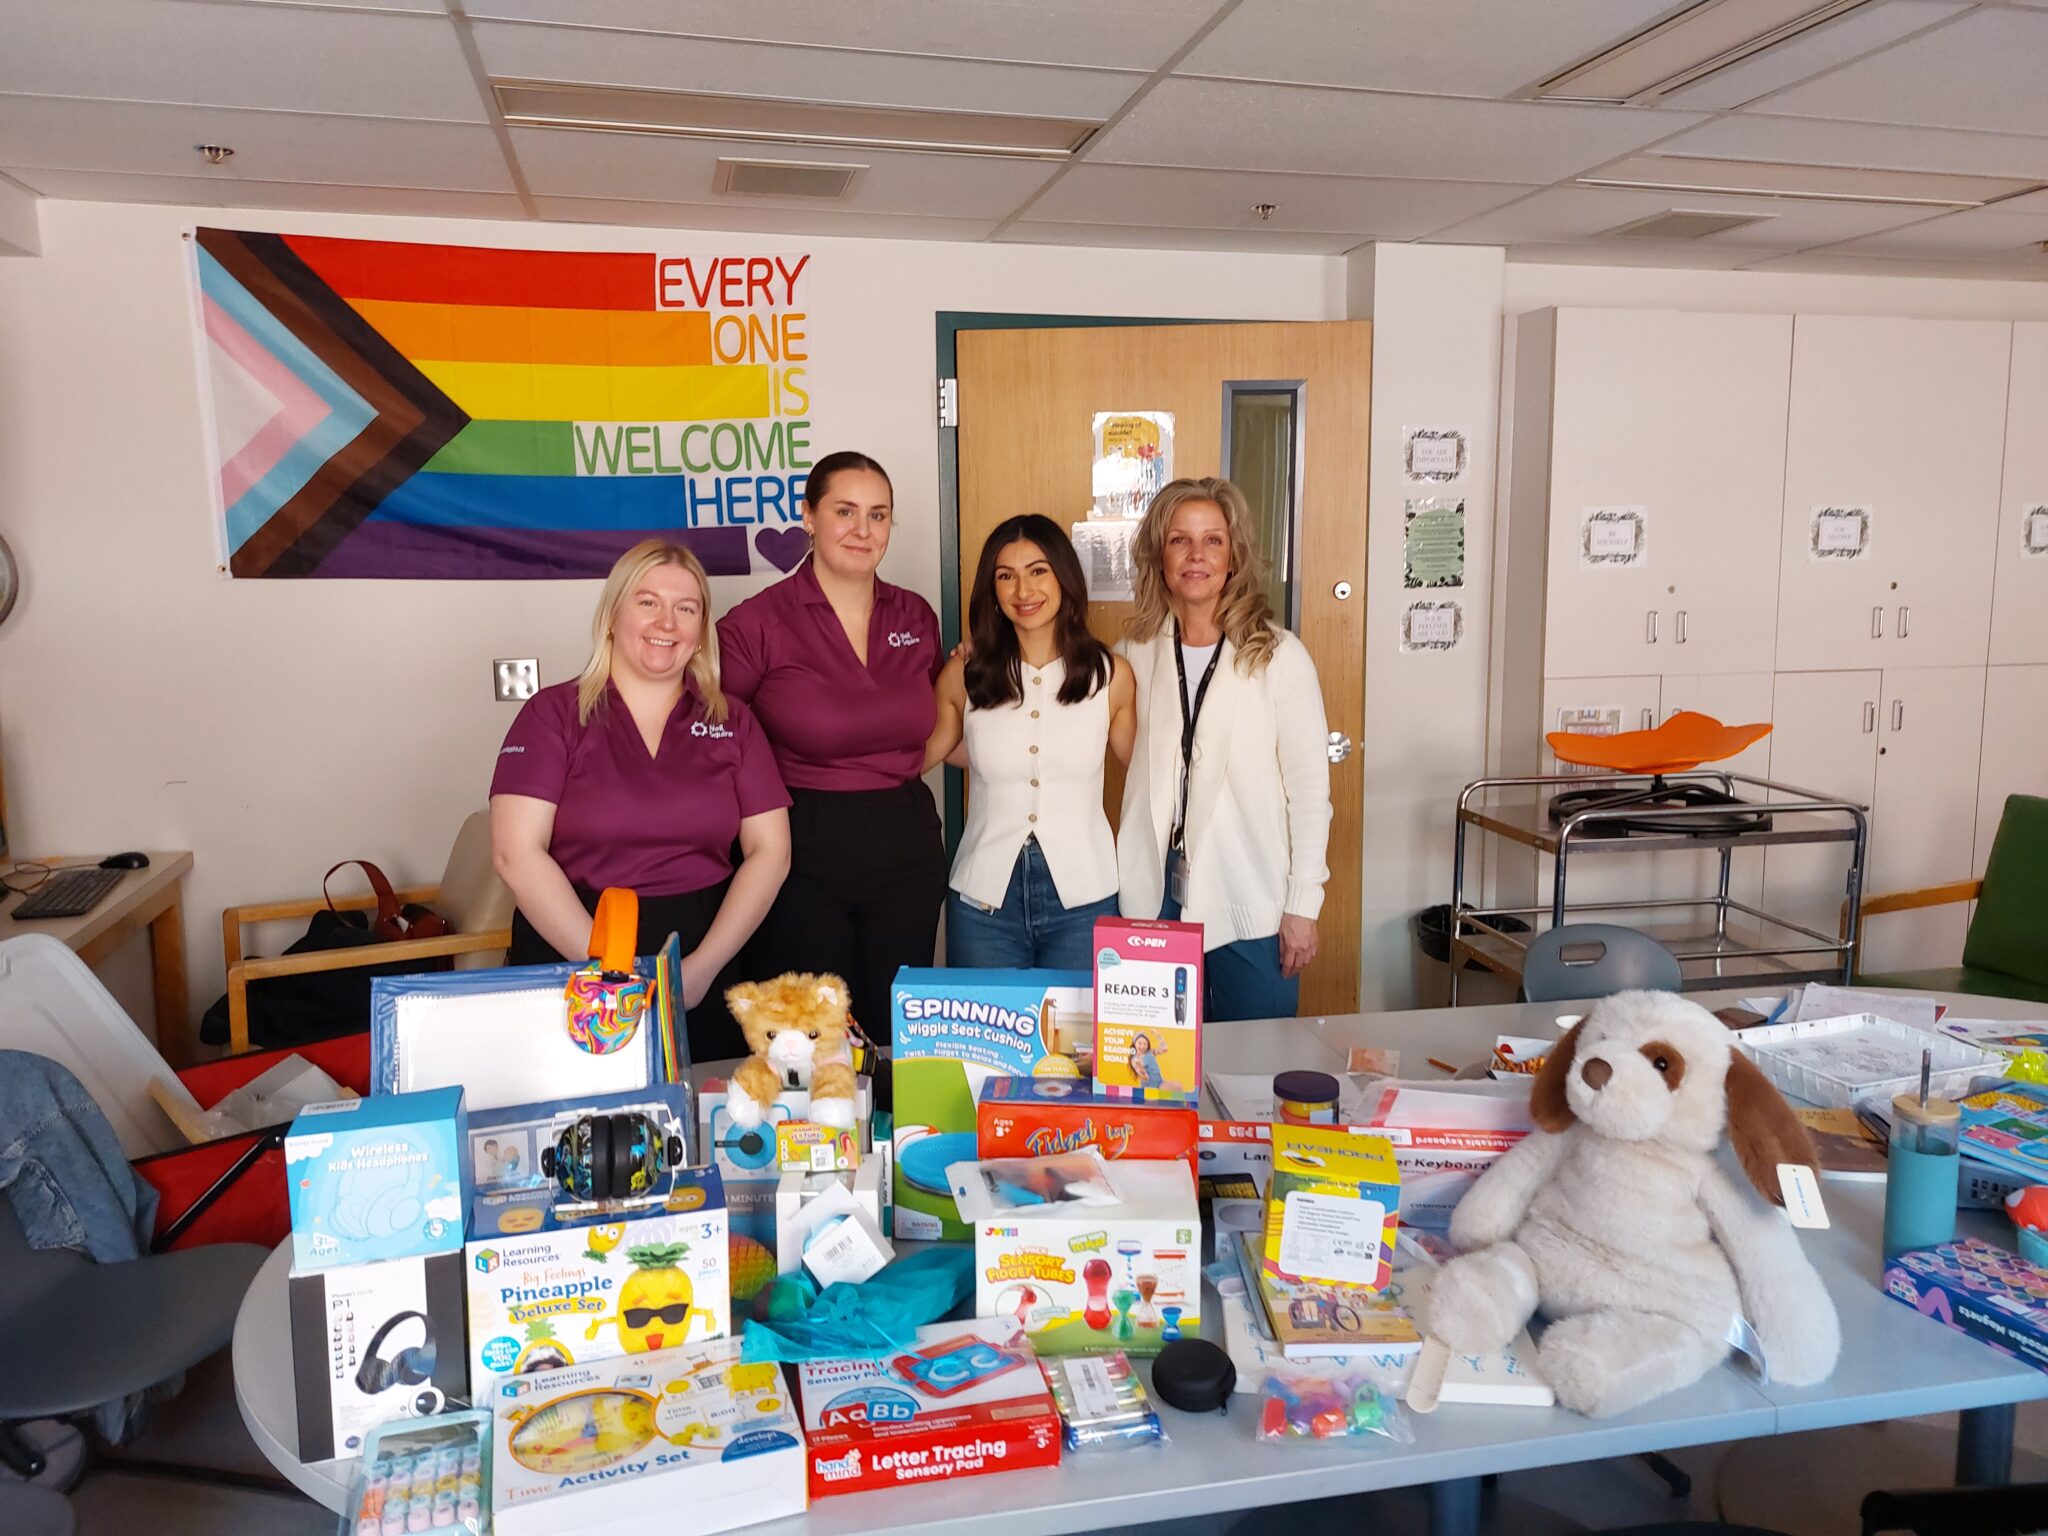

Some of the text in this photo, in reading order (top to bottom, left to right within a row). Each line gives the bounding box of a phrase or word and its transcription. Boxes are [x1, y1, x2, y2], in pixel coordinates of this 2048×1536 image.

[660, 256, 807, 308] EVERY
[714, 313, 807, 364] ONE
[773, 367, 810, 417] IS
[575, 421, 813, 475] WELCOME
[689, 474, 809, 526] HERE
[1105, 983, 1170, 999] READER 3
[903, 998, 1037, 1038] SPINNING
[907, 1022, 1032, 1053] Wiggle Seat Cushion
[351, 1143, 409, 1158] Wireless
[328, 1153, 429, 1172] Kids Headphones
[1415, 1158, 1492, 1171] Keyboard
[701, 1223, 721, 1240] 3+
[309, 1247, 339, 1257] Ages
[502, 1245, 552, 1258] Learning
[503, 1254, 560, 1268] Resources
[1000, 1254, 1066, 1267] SENSORY
[702, 1258, 717, 1269] 50
[523, 1267, 586, 1287] Big Feelings
[986, 1266, 1075, 1284] FIDGET TUBES
[500, 1276, 613, 1304] Pineapple
[512, 1299, 603, 1321] Deluxe Set
[1958, 1305, 2007, 1335] Magnets
[534, 1369, 591, 1384] Learning
[807, 1361, 884, 1377] Tracing
[535, 1375, 600, 1391] Resources
[807, 1373, 861, 1386] Sensory
[872, 1438, 1007, 1471] Letter Tracing
[558, 1460, 649, 1489] Activity
[655, 1450, 691, 1466] Set
[896, 1456, 984, 1481] Sensory Pad
